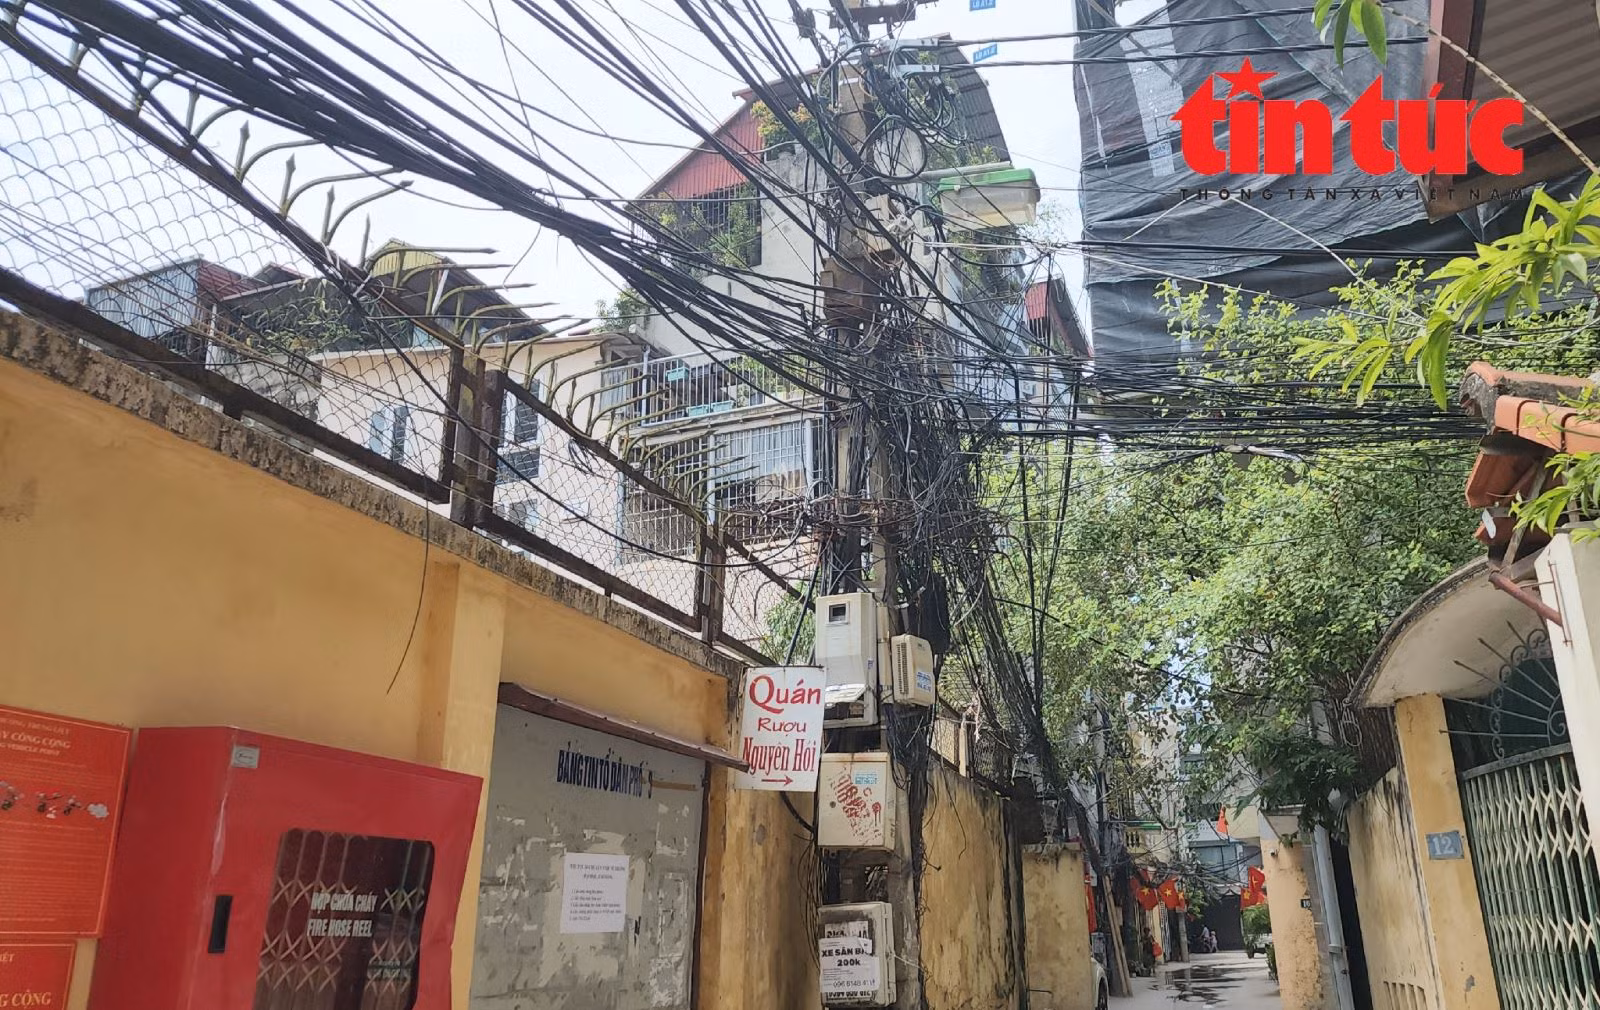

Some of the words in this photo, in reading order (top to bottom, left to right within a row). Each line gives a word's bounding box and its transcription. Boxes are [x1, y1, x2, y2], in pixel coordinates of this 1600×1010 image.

[749, 675, 821, 714] Quán
[757, 717, 807, 737] Rượu
[1432, 836, 1456, 856] 12
[307, 919, 329, 937] FIRE
[328, 919, 353, 937] HOSE
[352, 919, 373, 937] REEL
[822, 949, 834, 958] XE
[835, 946, 853, 956] SÂN
[837, 958, 861, 967] 200k
[11, 988, 52, 1009] CỘNG
